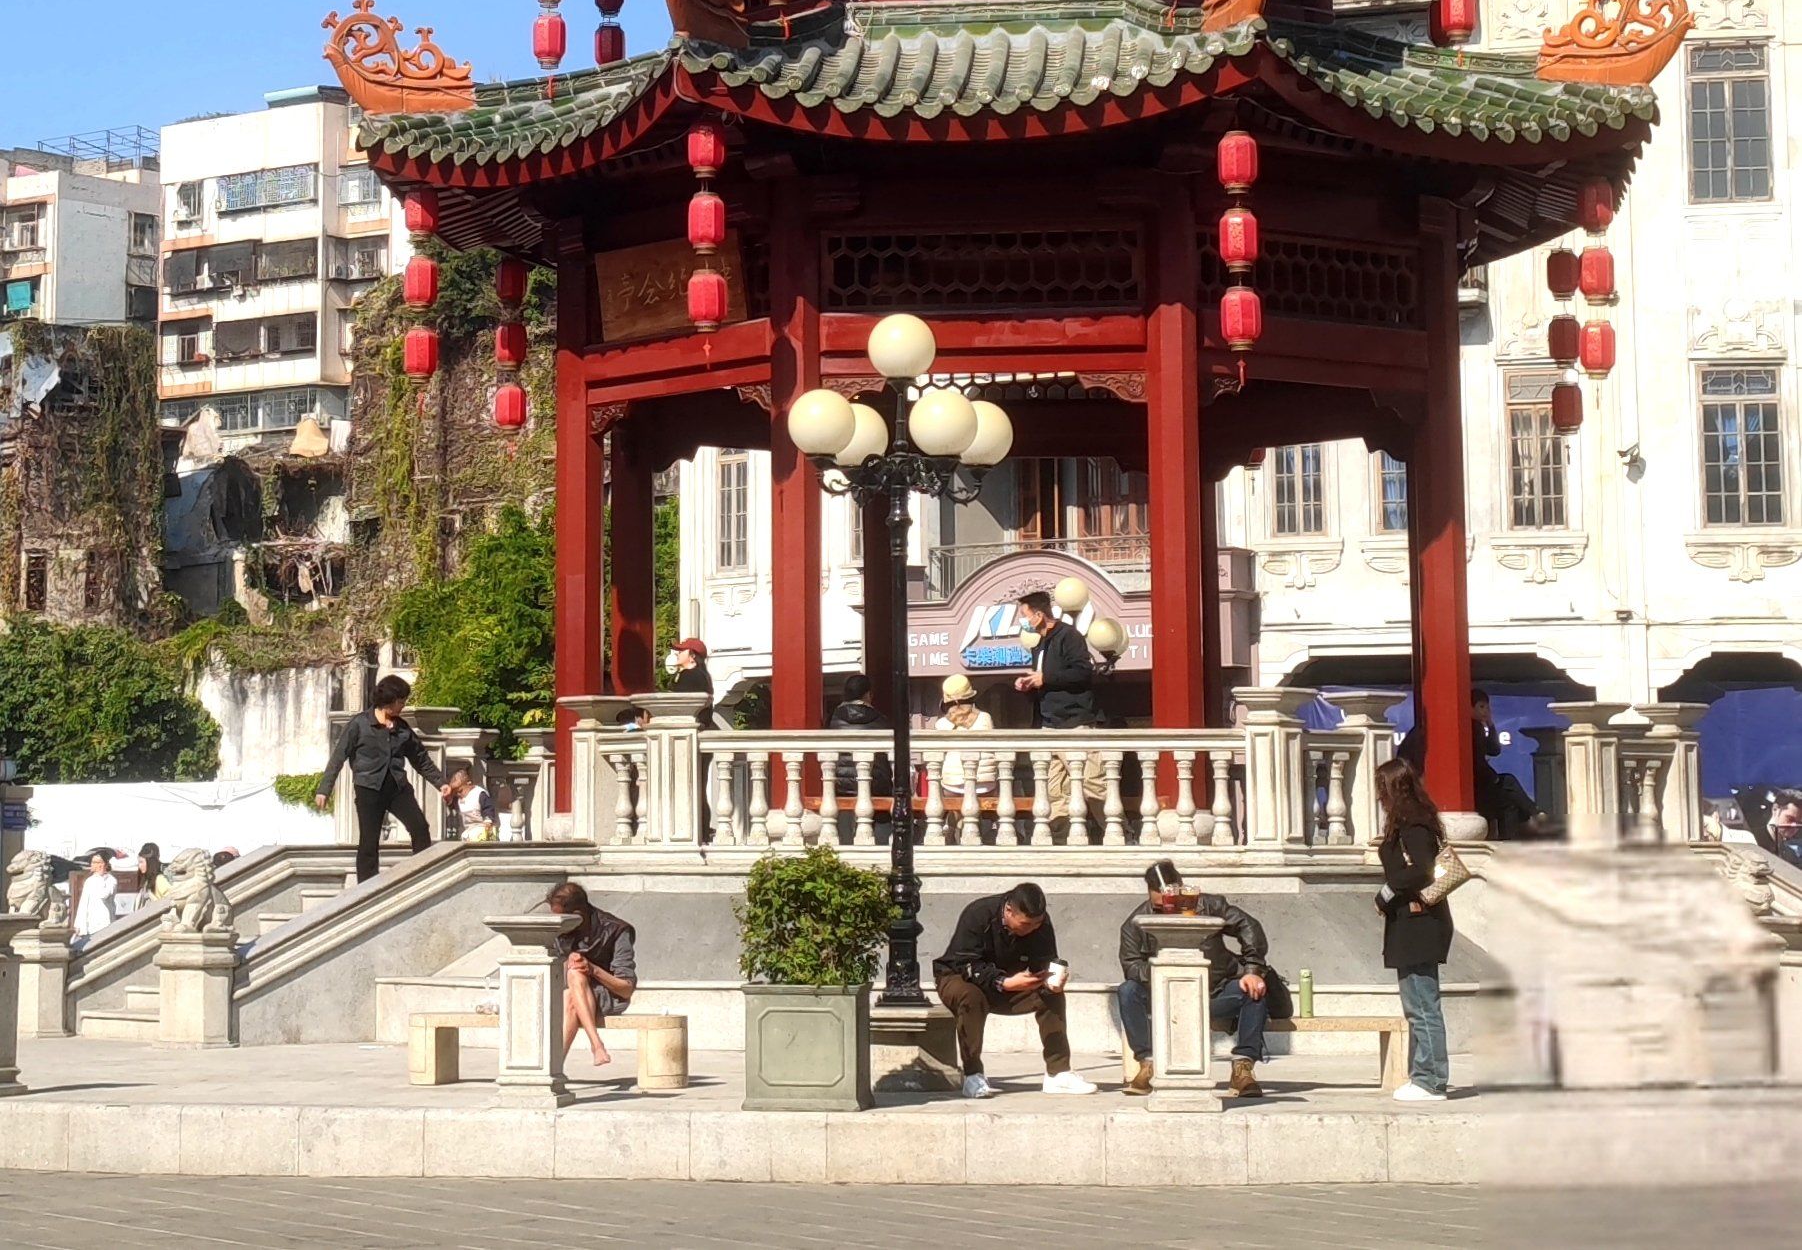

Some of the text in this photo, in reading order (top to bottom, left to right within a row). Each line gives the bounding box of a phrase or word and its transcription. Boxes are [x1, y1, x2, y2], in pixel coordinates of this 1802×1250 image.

[1126, 623, 1154, 638] LUC
[908, 632, 949, 647] GAME
[908, 652, 950, 667] TIME
[1128, 645, 1148, 659] TI
